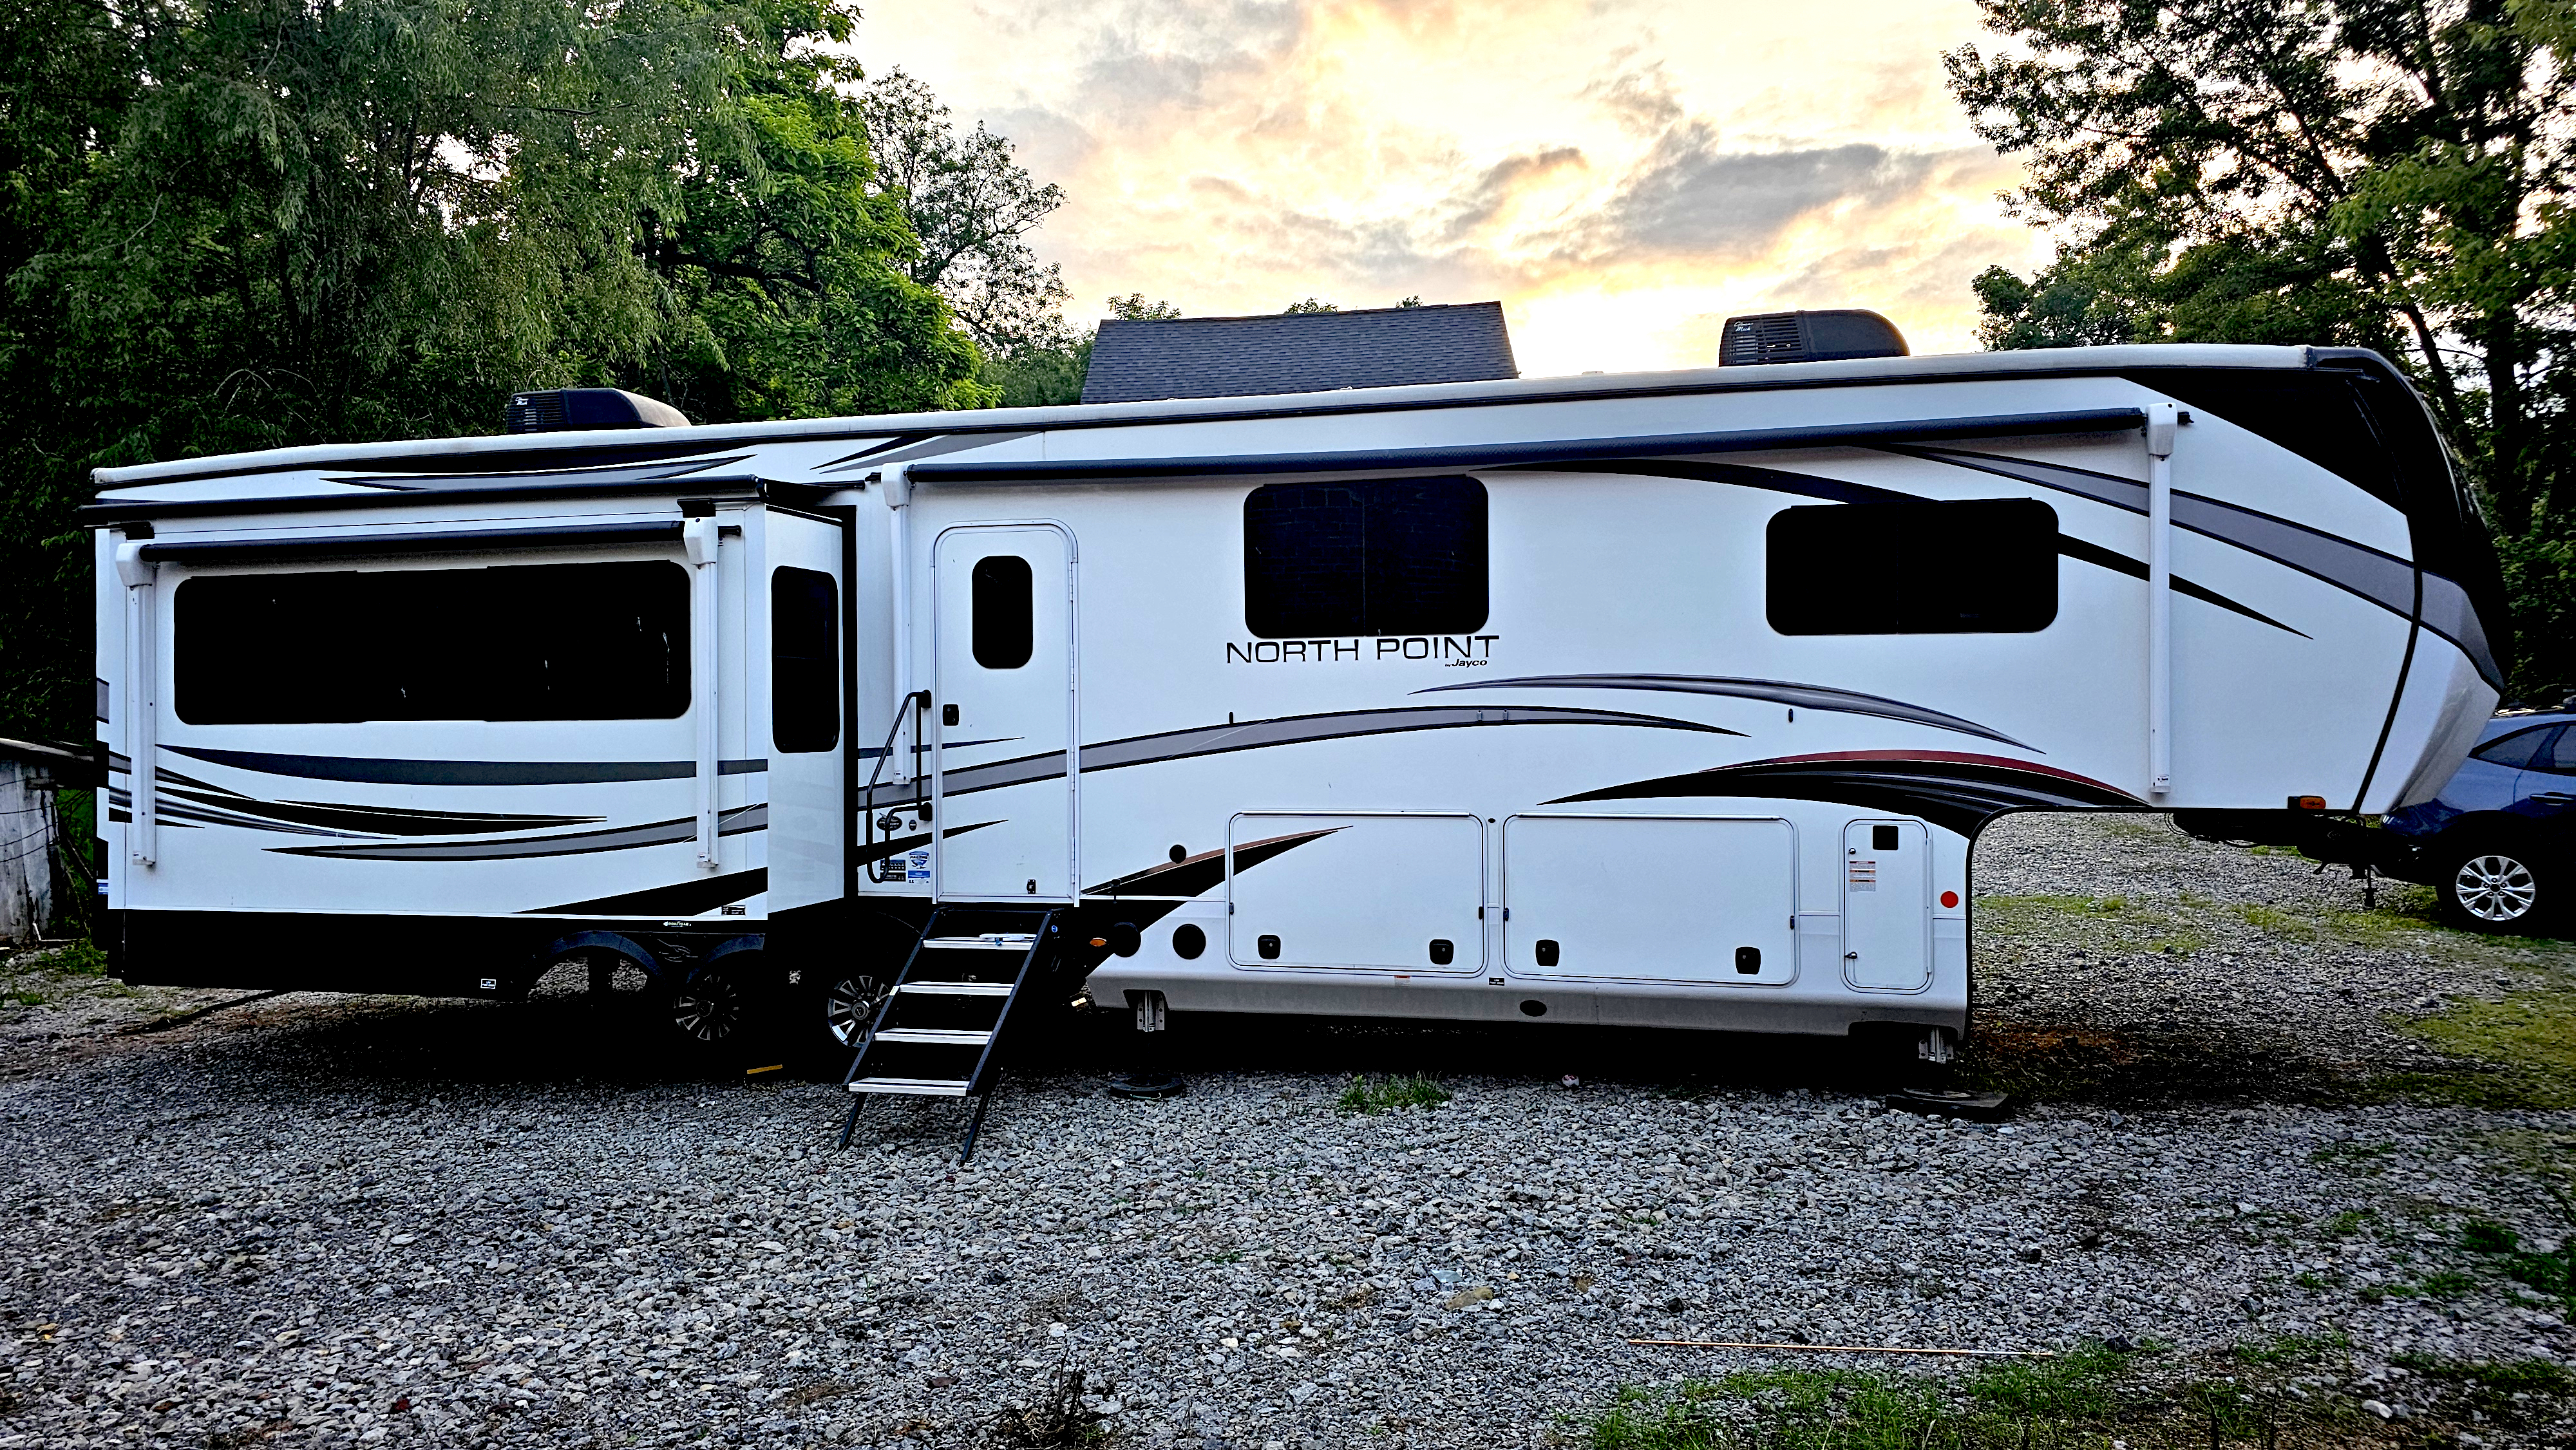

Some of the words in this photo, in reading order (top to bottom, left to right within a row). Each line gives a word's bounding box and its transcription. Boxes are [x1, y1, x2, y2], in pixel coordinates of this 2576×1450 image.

[1226, 639, 1359, 663] NORTH
[1377, 635, 1500, 660] POINT
[1452, 658, 1488, 668] Jayco
